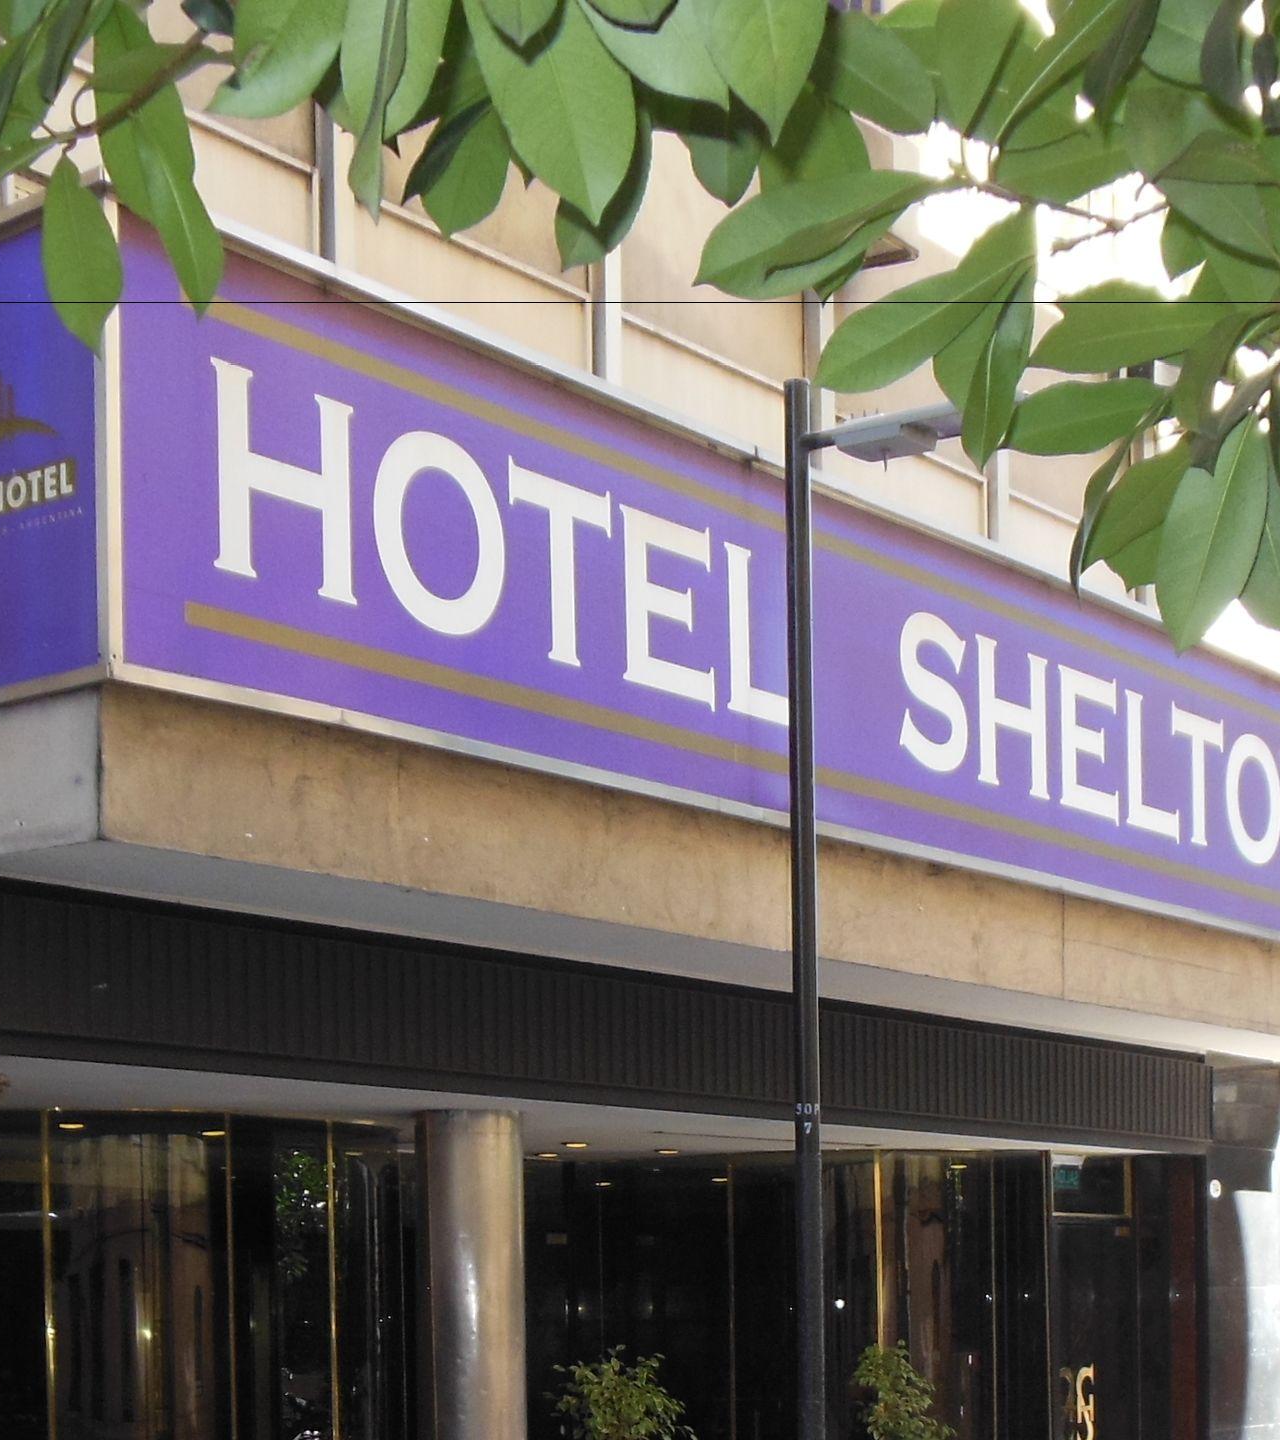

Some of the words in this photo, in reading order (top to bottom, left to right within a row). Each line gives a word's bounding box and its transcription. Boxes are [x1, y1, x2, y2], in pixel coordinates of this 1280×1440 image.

[19, 506, 83, 530] ARGENTINA
[210, 356, 789, 727] HOTEL
[803, 1122, 812, 1135] 7
